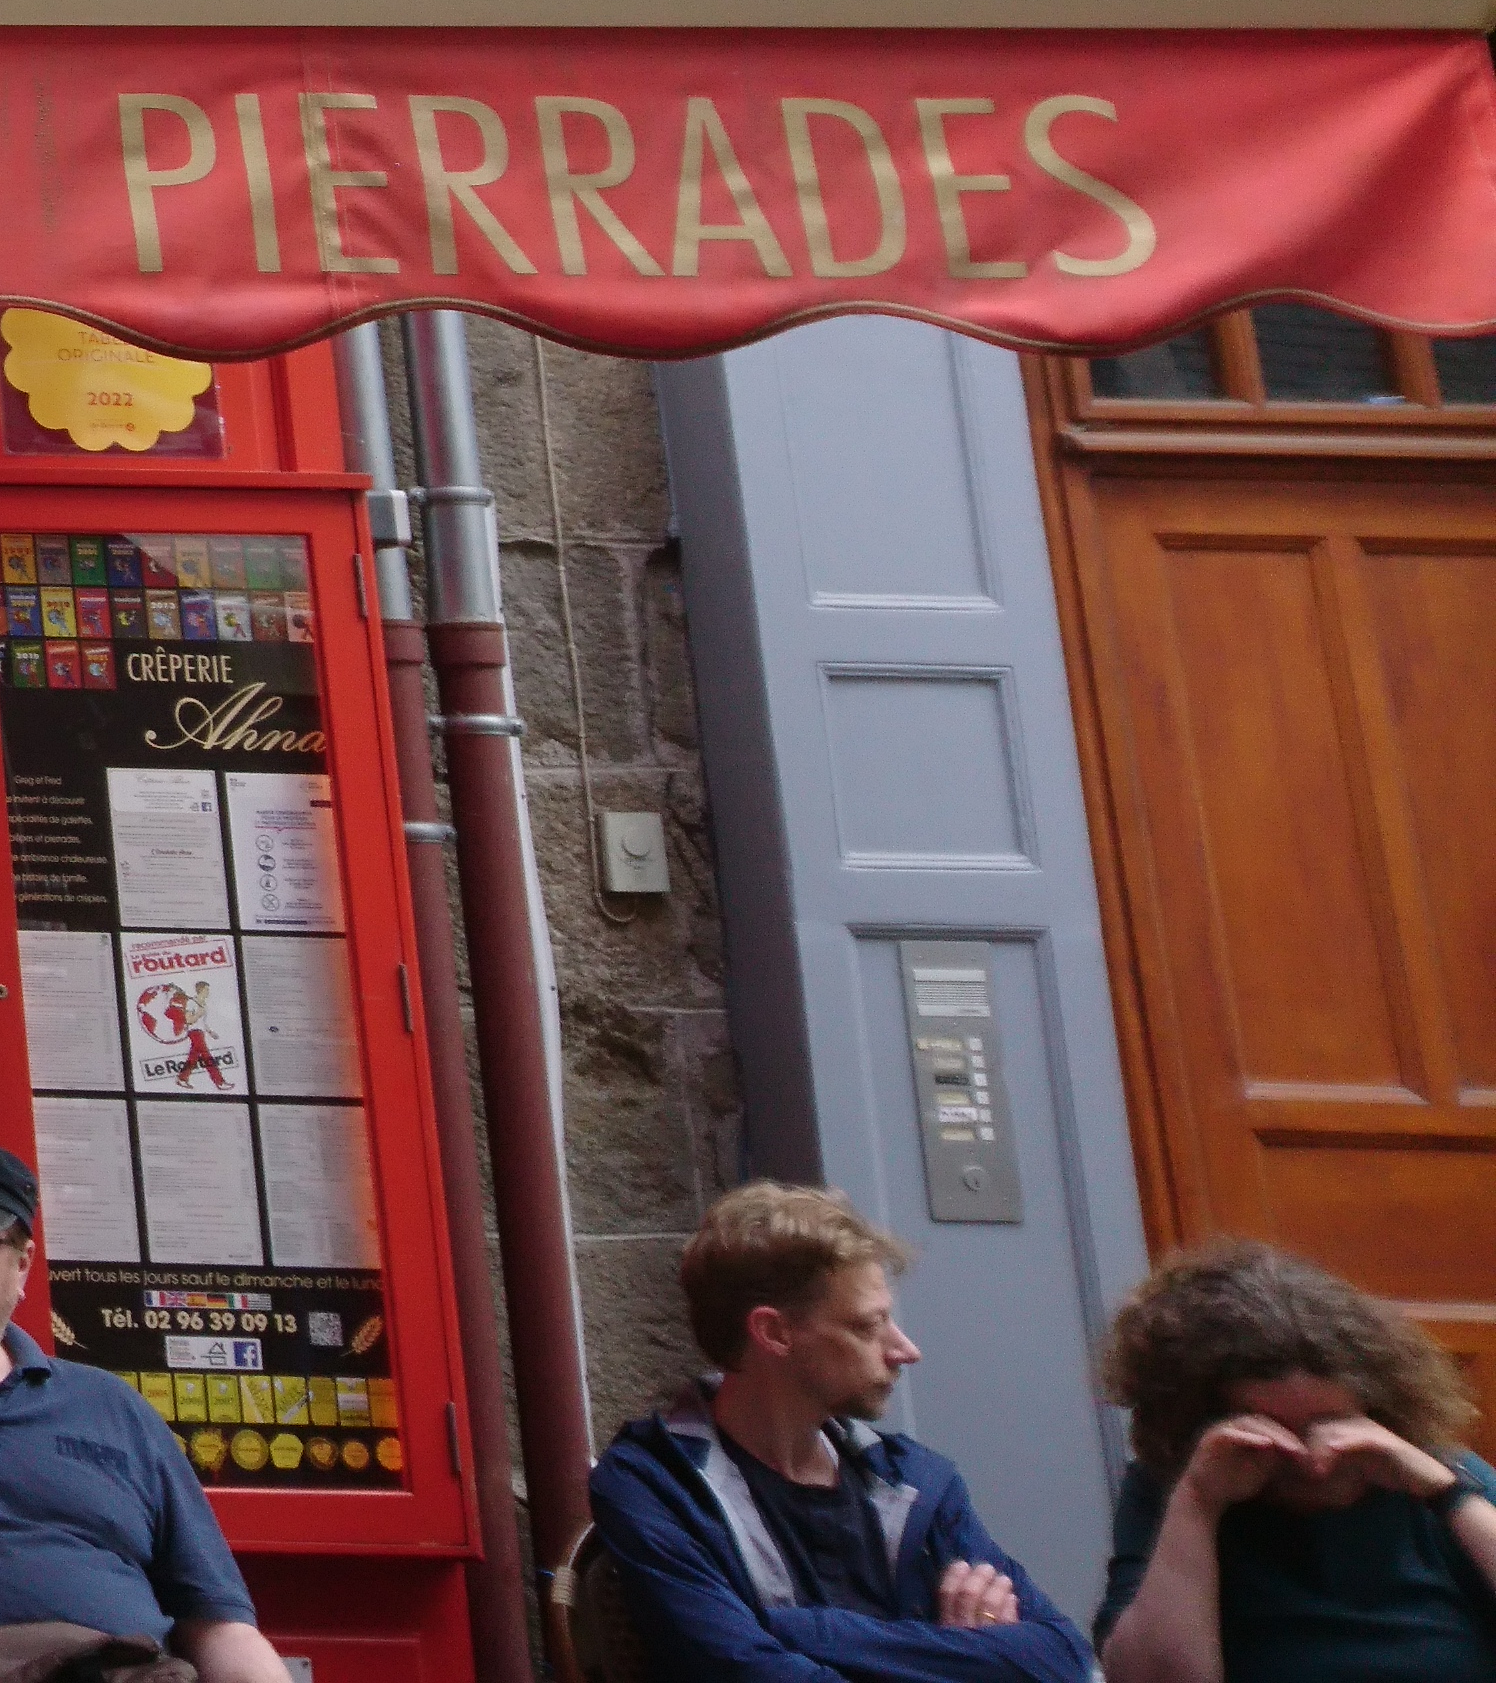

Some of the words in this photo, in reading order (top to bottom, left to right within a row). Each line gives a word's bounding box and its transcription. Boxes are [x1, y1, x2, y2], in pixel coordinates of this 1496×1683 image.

[118, 91, 1159, 279] PIERRADES
[78, 330, 130, 346] TABL
[57, 348, 155, 364] ORIGINALE
[86, 391, 134, 408] 2022
[126, 646, 235, 684] CRÊPERIE
[145, 680, 326, 753] Ahna
[131, 936, 190, 951] recommandé
[132, 946, 227, 974] routard
[49, 1269, 82, 1283] uvert
[84, 1269, 116, 1284] tous
[118, 1270, 141, 1284] les
[142, 1270, 179, 1287] jours
[180, 1270, 211, 1286] sauf
[214, 1271, 231, 1285] le
[232, 1271, 314, 1289] dimanche
[315, 1273, 332, 1289] et
[332, 1273, 351, 1289] le
[100, 1307, 139, 1328] Tél.
[144, 1311, 172, 1329] 02
[175, 1312, 205, 1330] 96
[209, 1312, 236, 1331] 39
[240, 1313, 269, 1332] 09
[273, 1313, 298, 1333] 13
